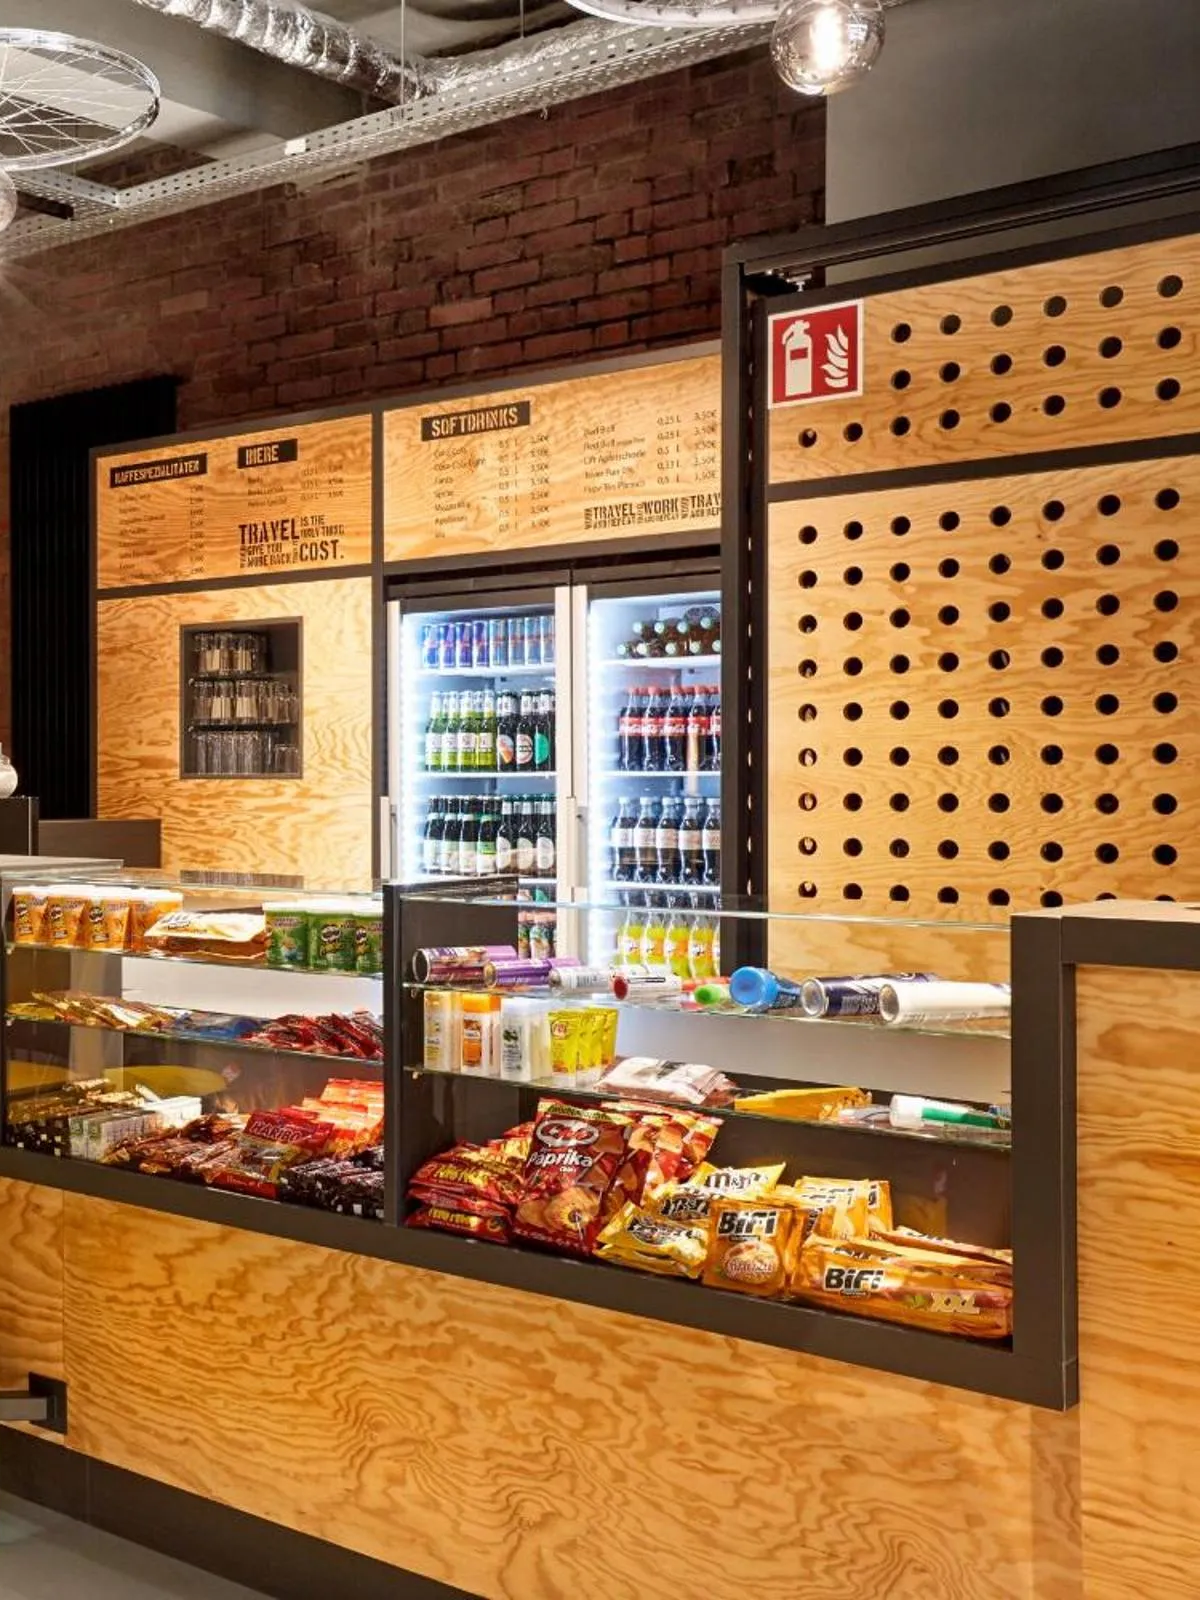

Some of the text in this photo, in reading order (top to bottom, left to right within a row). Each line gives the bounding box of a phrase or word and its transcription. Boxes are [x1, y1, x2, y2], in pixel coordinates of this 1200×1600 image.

[431, 406, 519, 438] SOFTDRINKS
[245, 444, 280, 466] BIERE
[593, 502, 636, 520] TRAVEL
[643, 498, 679, 515] WORK
[238, 518, 300, 545] TRAVEL
[300, 539, 344, 562] COST.
[248, 1121, 303, 1143] HARIBO
[526, 1149, 593, 1168] Paprika
[718, 1211, 777, 1235] BiFi
[824, 1268, 883, 1290] BiFi
